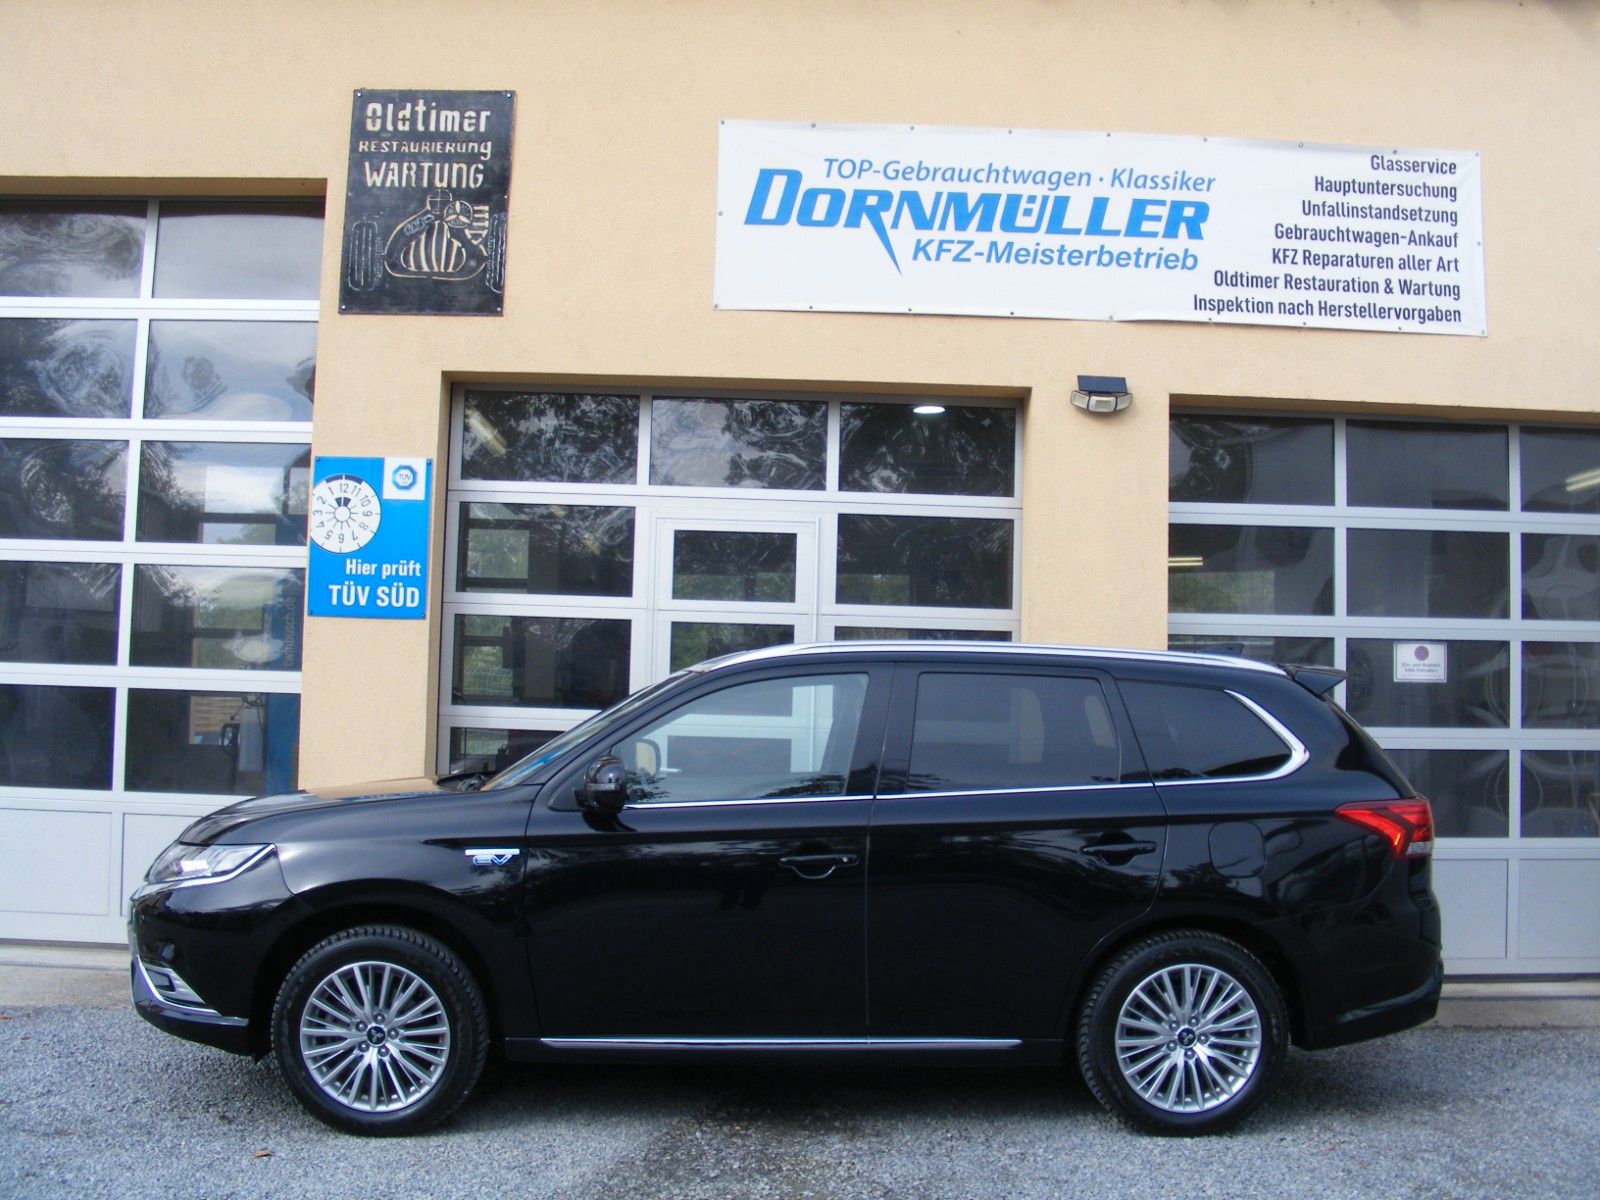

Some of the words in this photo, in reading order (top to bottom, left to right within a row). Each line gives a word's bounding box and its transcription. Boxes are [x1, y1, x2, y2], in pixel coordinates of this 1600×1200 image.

[366, 99, 491, 133] Oldtimer
[823, 157, 1092, 191] TOP-Gebrauchtwagen
[1110, 168, 1217, 193] Klassiker
[1370, 155, 1457, 175] Glasservice
[1314, 176, 1458, 202] Hauptuntersuchung
[1301, 200, 1458, 227] Unfallinstandsetzung
[1274, 223, 1459, 249] Gebrauchtwagen-Ankauf
[911, 238, 1200, 272] KFZ-Meisterbetrieb
[1272, 248, 1299, 266] KFZ
[1302, 250, 1394, 271] Reparaturen
[1398, 254, 1432, 272] aller
[1436, 256, 1460, 273] Art
[1213, 270, 1281, 290] Oldtimer
[1284, 273, 1380, 295] Restauration
[1383, 277, 1395, 295] &
[1399, 278, 1461, 301] Wartung
[1193, 294, 1274, 315] Inspektion
[1278, 299, 1314, 317] nach
[1318, 301, 1462, 325] Herstellervorgaben
[338, 483, 350, 494] 12
[345, 558, 378, 576] Hier
[381, 560, 422, 580] prüft
[328, 581, 371, 607] TÜV
[376, 582, 420, 609] SÜD
